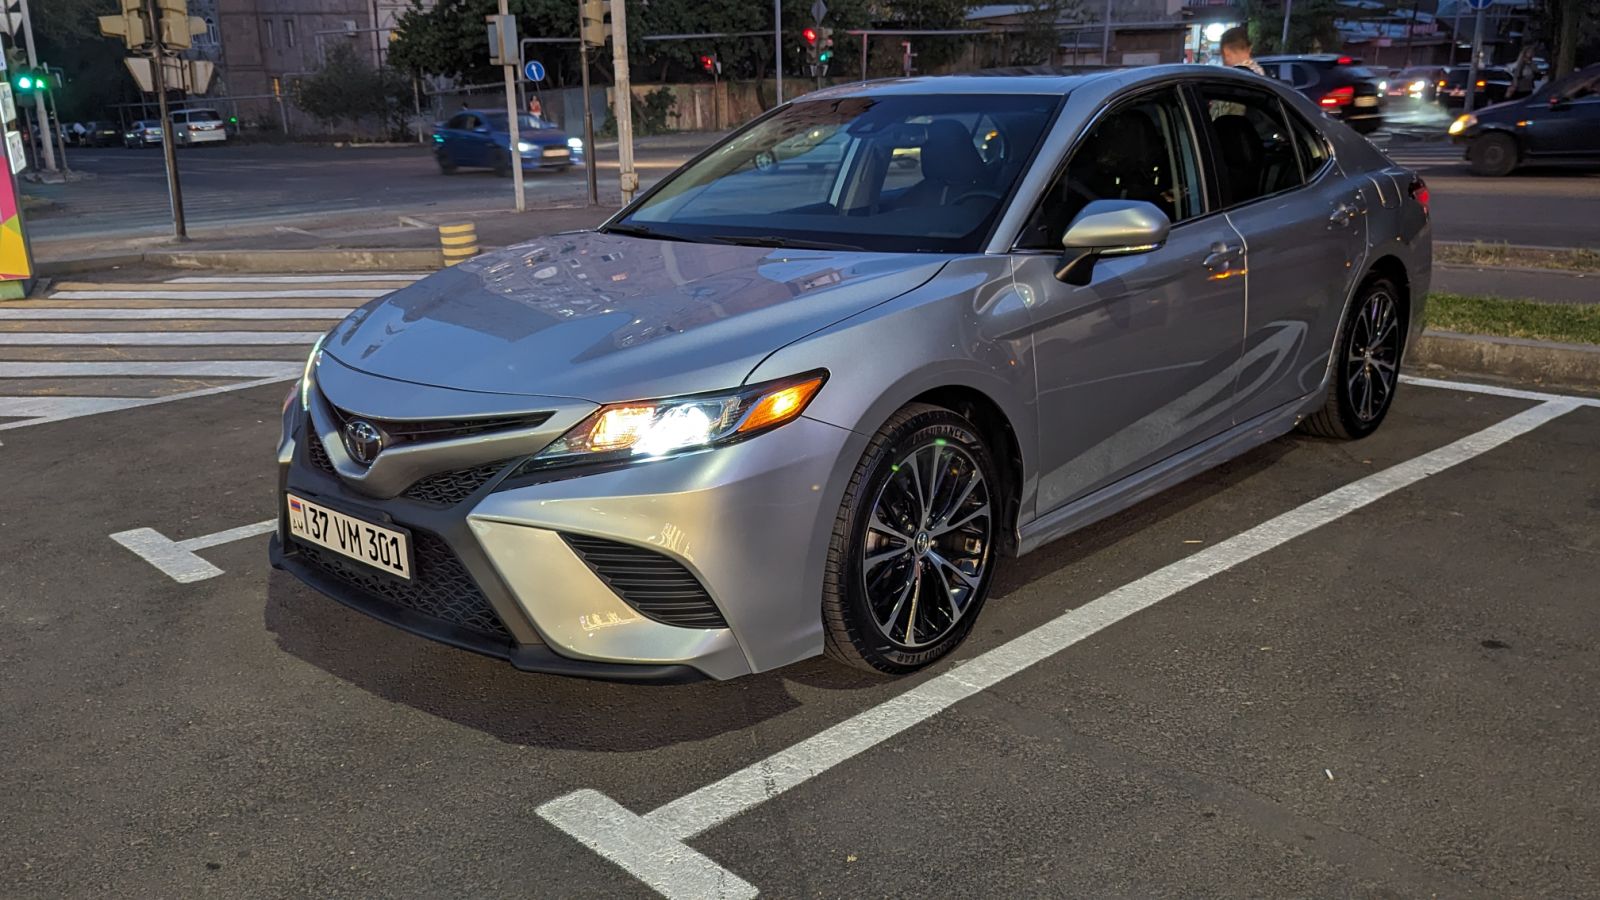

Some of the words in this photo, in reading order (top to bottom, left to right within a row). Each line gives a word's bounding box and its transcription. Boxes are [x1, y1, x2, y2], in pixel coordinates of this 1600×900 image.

[309, 508, 329, 543] 37
[334, 517, 363, 556] VM
[366, 528, 403, 571] 301
